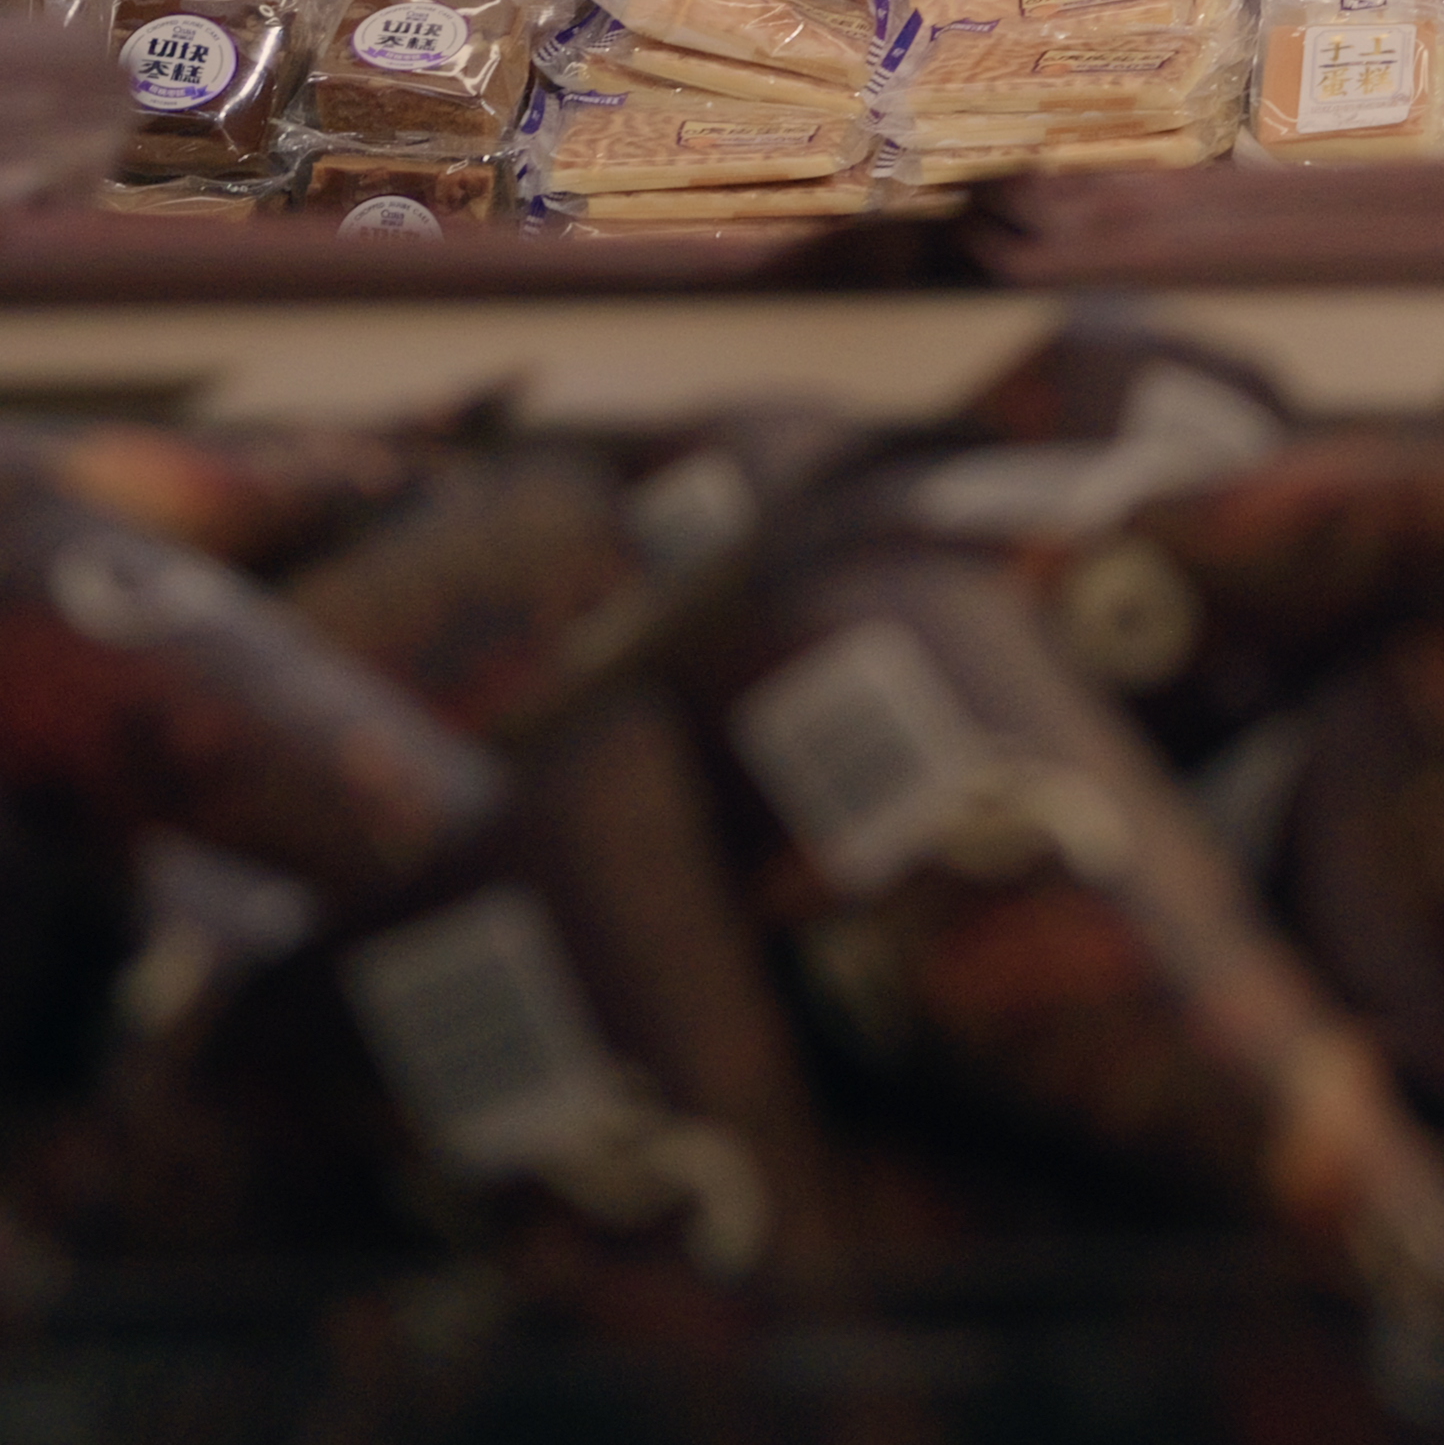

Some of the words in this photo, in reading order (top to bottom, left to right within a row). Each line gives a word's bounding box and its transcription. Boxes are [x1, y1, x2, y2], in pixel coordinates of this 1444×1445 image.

[147, 38, 210, 64] 切块
[1319, 32, 1397, 62] 手工
[1319, 66, 1396, 98] 蛋糕
